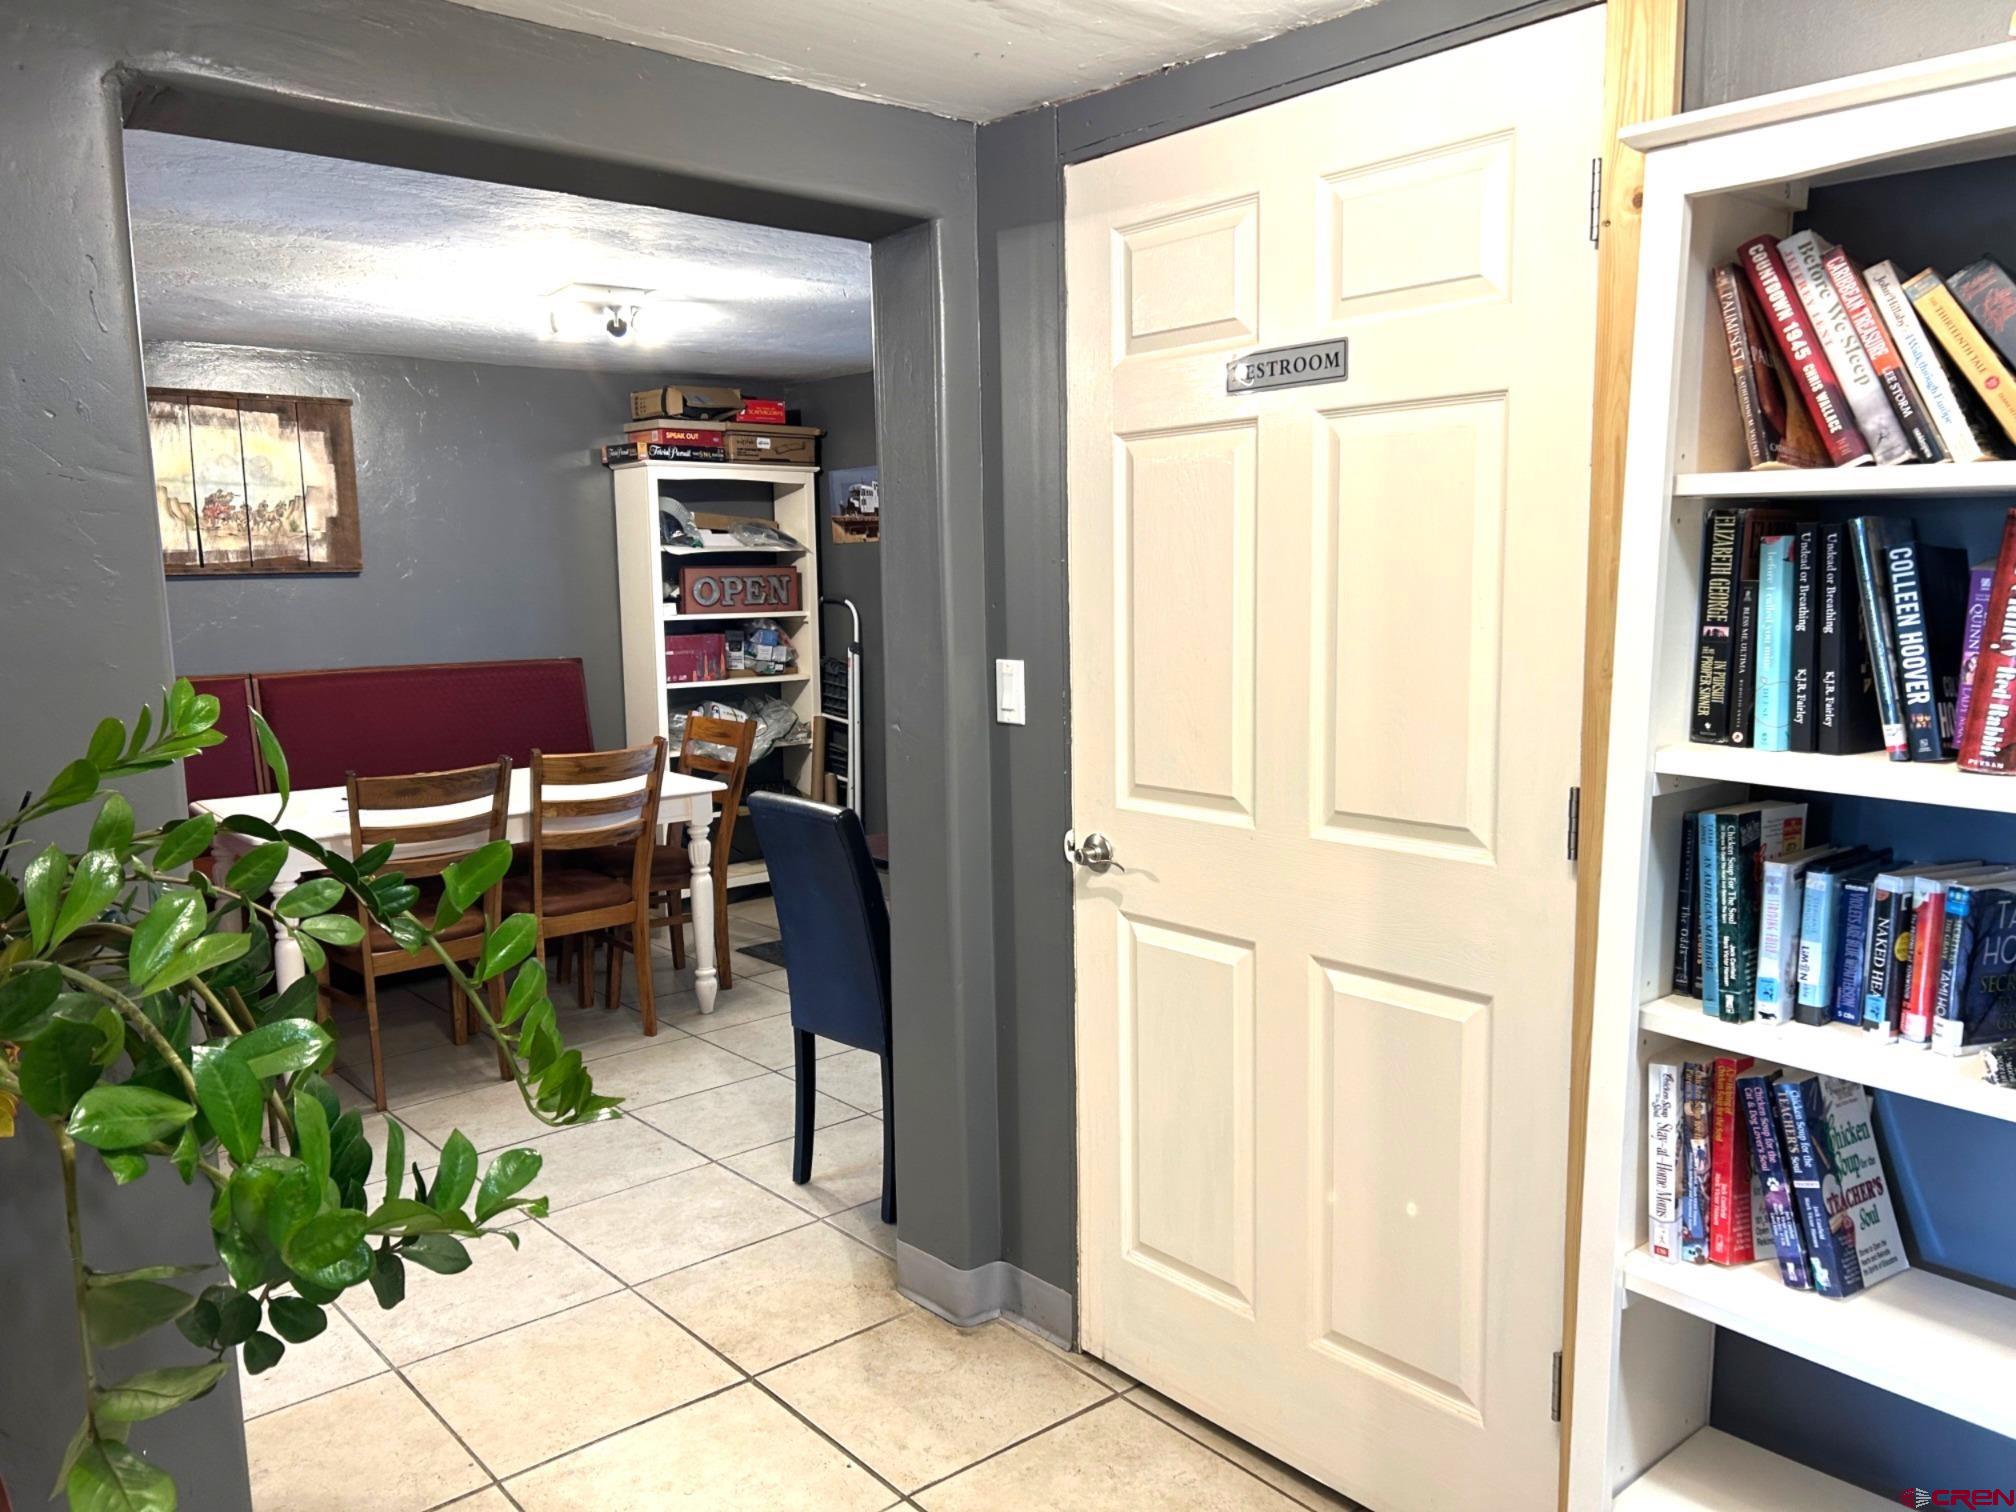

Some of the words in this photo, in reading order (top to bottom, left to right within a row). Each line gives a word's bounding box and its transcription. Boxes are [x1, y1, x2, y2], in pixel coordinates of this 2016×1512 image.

[1748, 243, 1795, 322] COUNTDOWN
[1782, 321, 1812, 361] 1945
[1783, 250, 1815, 306] JEFFREY
[1812, 312, 1832, 346] LENT
[1797, 240, 1831, 300] Before
[1828, 301, 1848, 333] We
[1841, 334, 1871, 386] Sleep
[1825, 255, 1868, 312] CARIBBEAN
[1850, 307, 1889, 361] TREASURE
[1720, 292, 1746, 361] PALIMPSEST
[1935, 307, 1974, 356] THIRTEENTH
[1970, 356, 1987, 373] TALE
[1873, 274, 1891, 298] John
[1885, 291, 1907, 327] Hillaby
[1907, 337, 1922, 369] Walk
[1919, 360, 1939, 396] through
[1934, 393, 1953, 424] Europe
[1802, 362, 1824, 393] CHRIS
[1816, 391, 1843, 434] WALLACE
[1881, 366, 1897, 385] LEE
[1889, 382, 1914, 418] STORM
[666, 432, 686, 440] SPEAK
[686, 432, 699, 440] OUT
[1710, 516, 1736, 575] ELIZABETH
[1800, 532, 1812, 570] Undead
[1826, 533, 1838, 572] Undead
[1767, 551, 1777, 583] before
[1800, 572, 1808, 582] or
[1826, 573, 1834, 584] or
[692, 575, 792, 608] OPEN
[1707, 578, 1731, 622] GEORGE
[1889, 547, 1921, 628] COLLEEN
[1742, 606, 1750, 627] BLESS
[1794, 584, 1810, 632] Breathing
[1823, 585, 1837, 634] Breathing
[1969, 603, 1984, 650] QUINN
[1699, 656, 1714, 686] PROPER
[1713, 661, 1727, 670] IN
[1739, 643, 1748, 673] ULTIMA
[1899, 631, 1931, 706] HOOVER
[1711, 672, 1726, 704] PURSUIT
[1991, 666, 2016, 700] Red
[1697, 687, 1711, 716] SINNER
[1793, 694, 1807, 725] Fairley
[1822, 697, 1835, 728] Fairley
[1979, 703, 2010, 757] Rabbit
[1727, 825, 1736, 855] Chicken
[1703, 856, 1713, 869] AN
[1726, 857, 1737, 876] Soup
[1703, 870, 1713, 921] AMERICAN
[1727, 877, 1737, 890] For
[1727, 891, 1737, 906] The
[1680, 906, 1691, 924] The
[1728, 908, 1737, 925] Soul
[1847, 893, 1865, 924] VIOLETS
[1680, 928, 1690, 955] Odds
[1846, 924, 1863, 938] ARE
[1944, 919, 1953, 934] THE
[1951, 919, 1963, 951] SECRETS
[1704, 925, 1714, 972] MARRIAGE
[1845, 939, 1860, 957] BLUE
[1873, 917, 1890, 968] NAKED
[1942, 935, 1951, 959] GRAVE
[1842, 966, 1859, 1007] PATTERSON
[1870, 968, 1885, 998] HEA
[1938, 968, 1952, 997] TAMI
[1935, 997, 1949, 1018] HO
[1662, 1073, 1675, 1099] Chicken
[1744, 1087, 1754, 1100] Cat
[1660, 1101, 1672, 1118] Soup
[1753, 1087, 1767, 1116] Chicken
[1790, 1090, 1804, 1120] Chicken
[1748, 1110, 1758, 1126] Dog
[1760, 1117, 1770, 1137] Soup
[1777, 1092, 1800, 1154] TEACHER'S
[1790, 1156, 1804, 1174] Soul
[1796, 1121, 1808, 1142] Soup
[1752, 1126, 1765, 1154] Lover's
[1764, 1138, 1775, 1150] for
[1801, 1142, 1811, 1152] for
[1825, 1113, 1872, 1155] Chicken
[1651, 1122, 1674, 1188] Stay-at-Home
[1758, 1154, 1771, 1172] Soul
[1767, 1151, 1777, 1164] the
[1803, 1155, 1814, 1168] the
[1834, 1150, 1862, 1184] Soup
[1867, 1156, 1876, 1166] the
[1656, 1190, 1673, 1217] Moms
[1826, 1176, 1884, 1217] TEACHER'S
[1860, 1203, 1880, 1231] Soul
